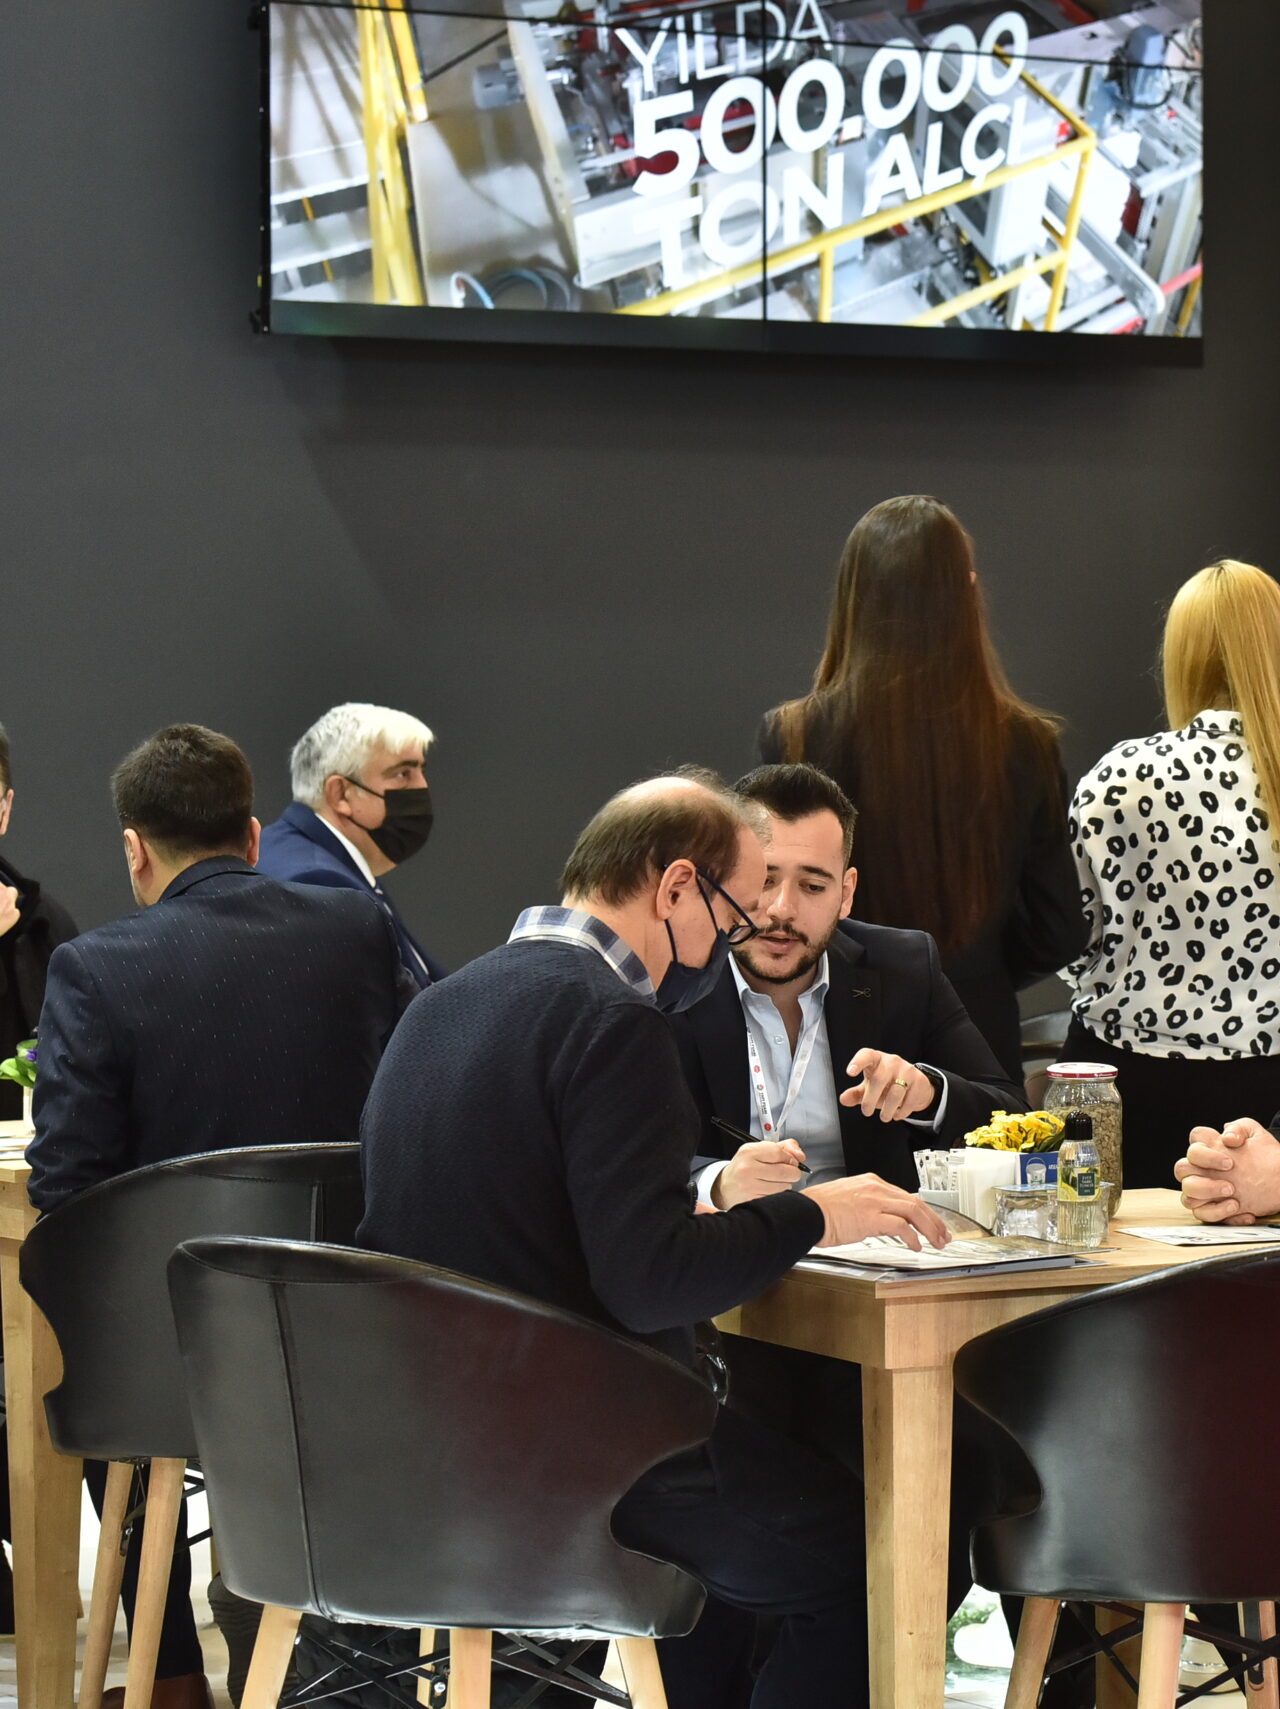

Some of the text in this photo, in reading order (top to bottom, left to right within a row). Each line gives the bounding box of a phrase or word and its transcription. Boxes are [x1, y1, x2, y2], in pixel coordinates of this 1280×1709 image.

[615, 0, 832, 92] YILDA
[633, 12, 1030, 196] 500.000
[632, 153, 844, 290] TON
